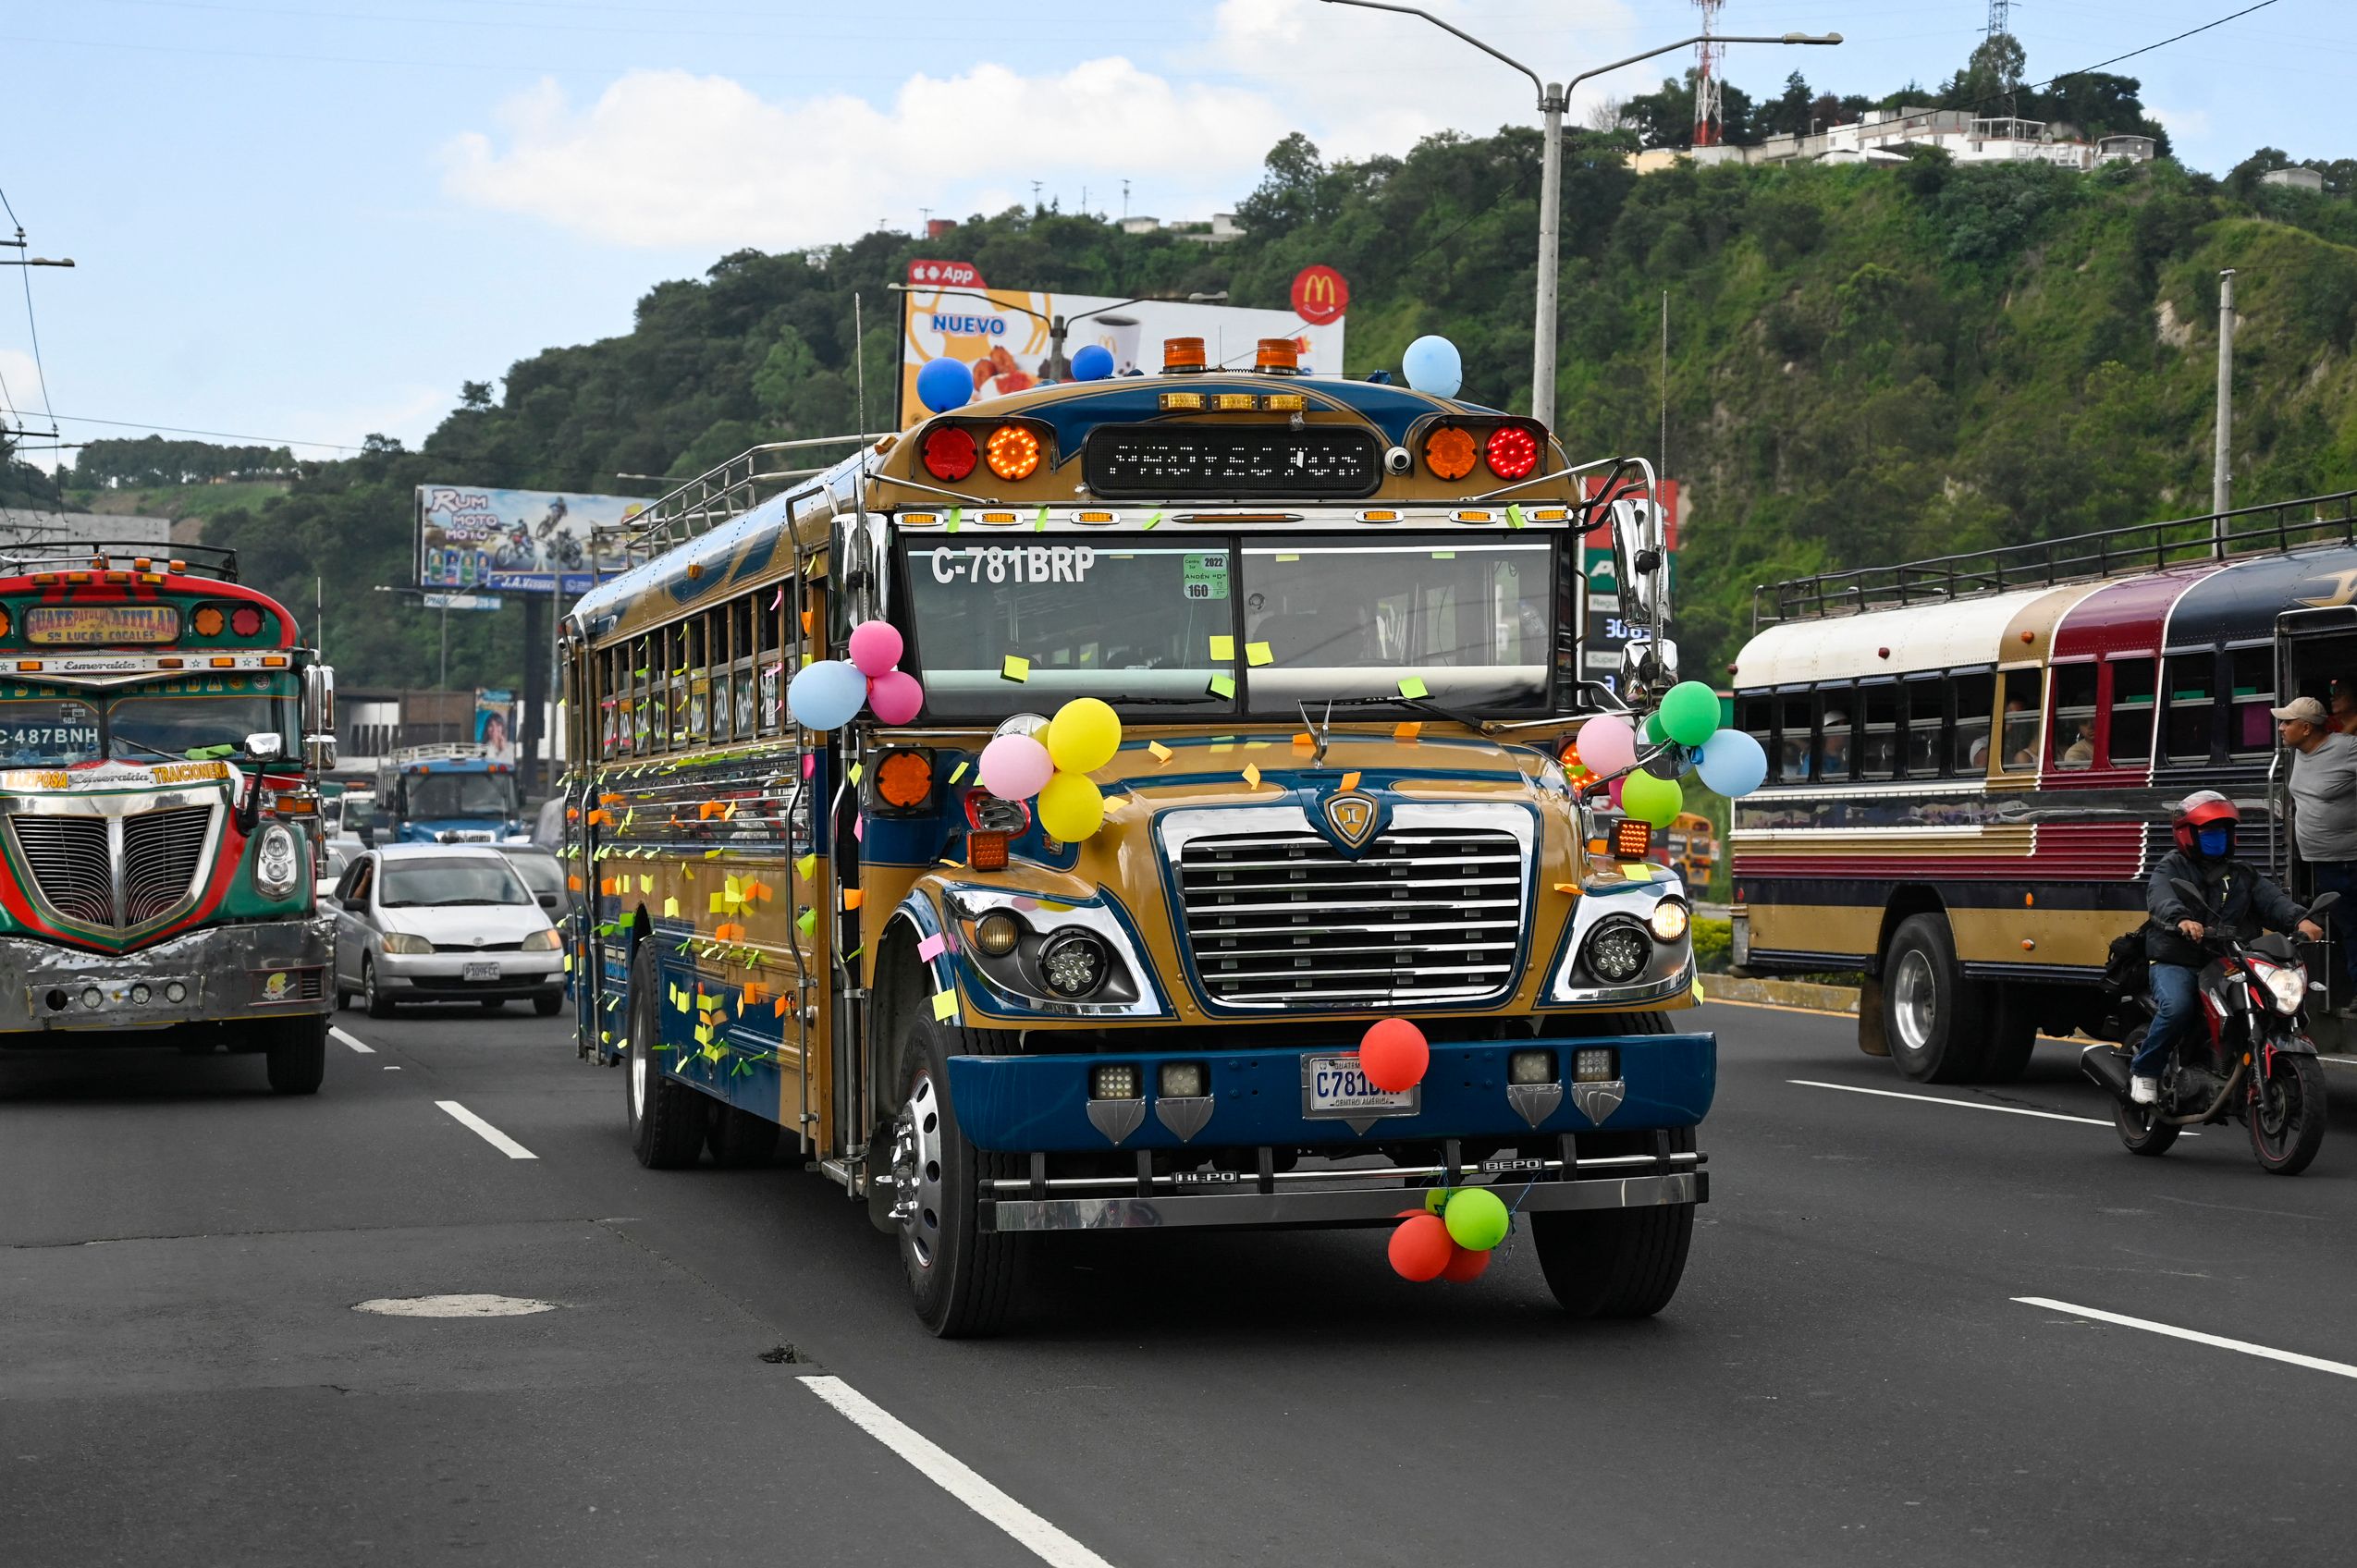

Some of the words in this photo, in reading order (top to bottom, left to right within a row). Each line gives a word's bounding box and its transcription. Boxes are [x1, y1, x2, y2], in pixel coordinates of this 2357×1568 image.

[942, 266, 974, 283] App
[932, 314, 1005, 336] NUEVO
[452, 514, 498, 527] MOTO
[931, 545, 1095, 584] C-781BRP
[1205, 557, 1223, 568] 2022
[1188, 584, 1209, 597] 160
[28, 609, 74, 635] GUATE
[67, 631, 104, 642] LUCAS
[109, 631, 156, 641] COCALES
[64, 660, 137, 671] Esmeralda
[152, 762, 230, 785] TRAICIONERA
[1335, 1098, 1359, 1107] CENTRO
[1485, 1159, 1540, 1170] BEPO
